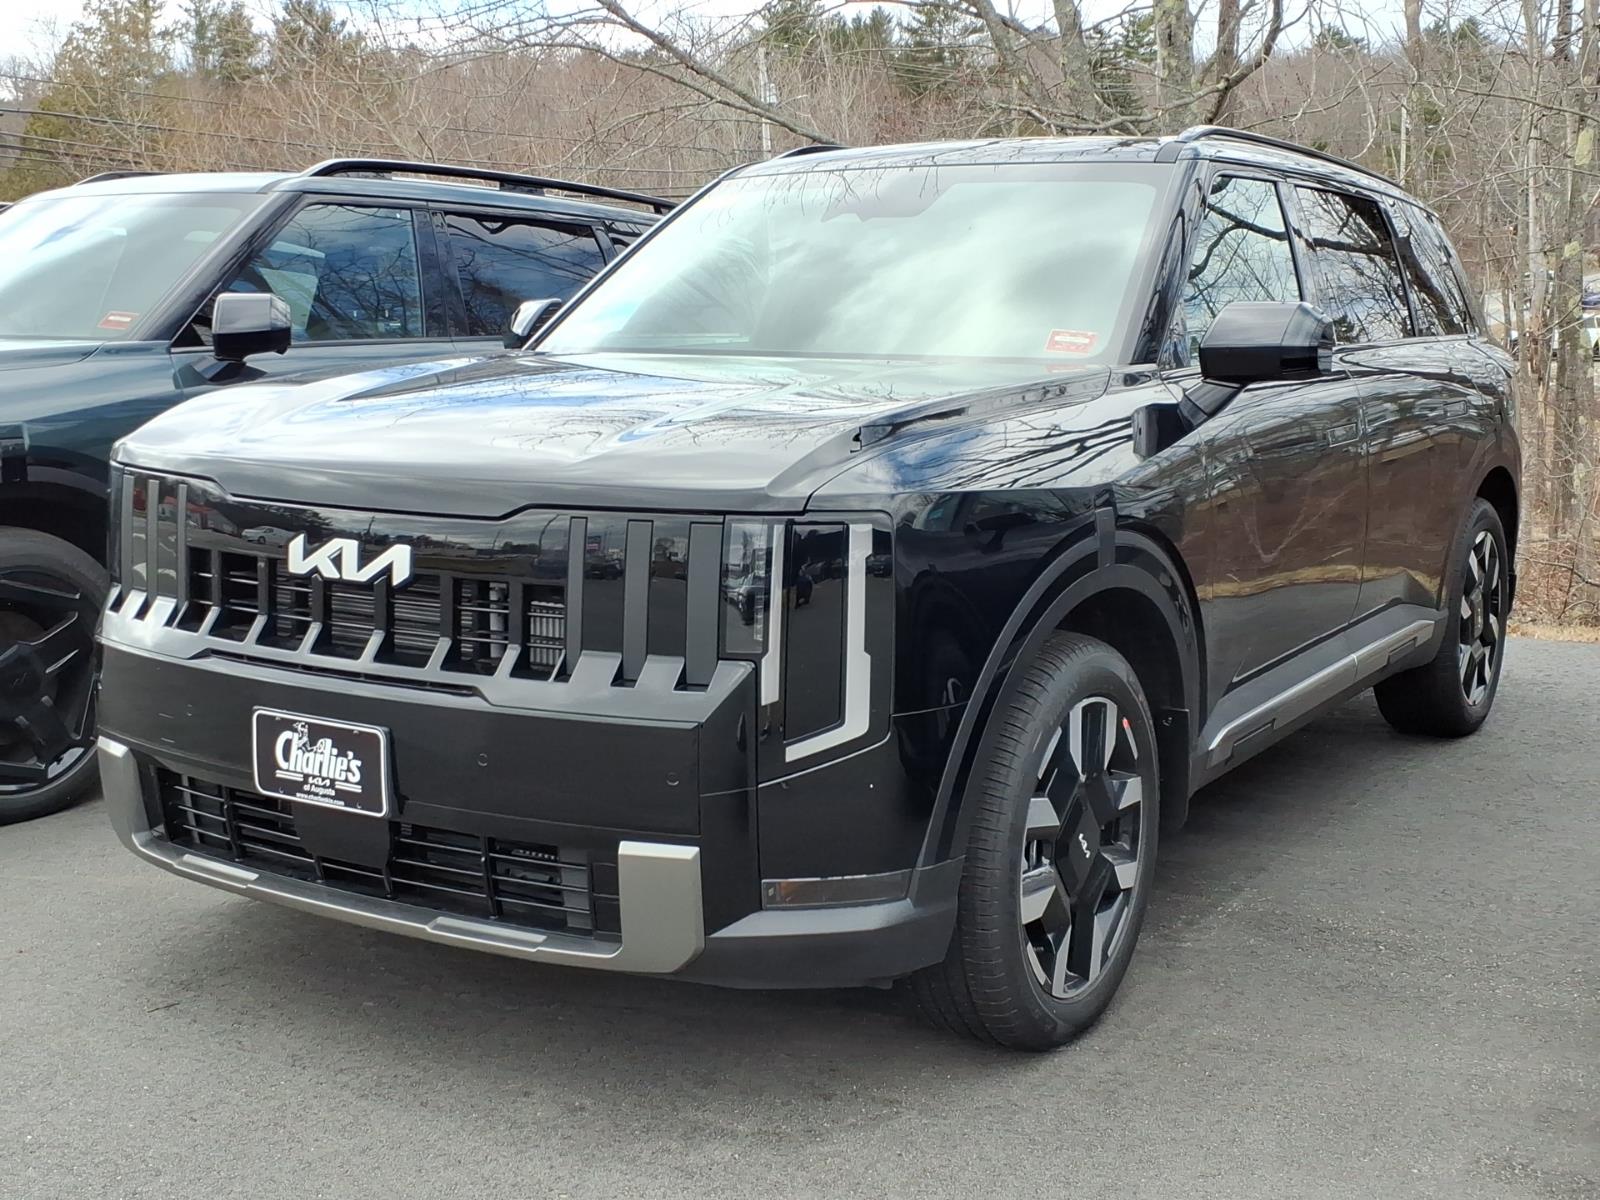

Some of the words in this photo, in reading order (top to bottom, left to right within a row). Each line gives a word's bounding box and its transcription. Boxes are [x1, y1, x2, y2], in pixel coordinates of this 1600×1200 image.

[288, 533, 411, 587] KIA
[275, 730, 361, 783] Charlie's
[311, 784, 335, 796] Augusta
